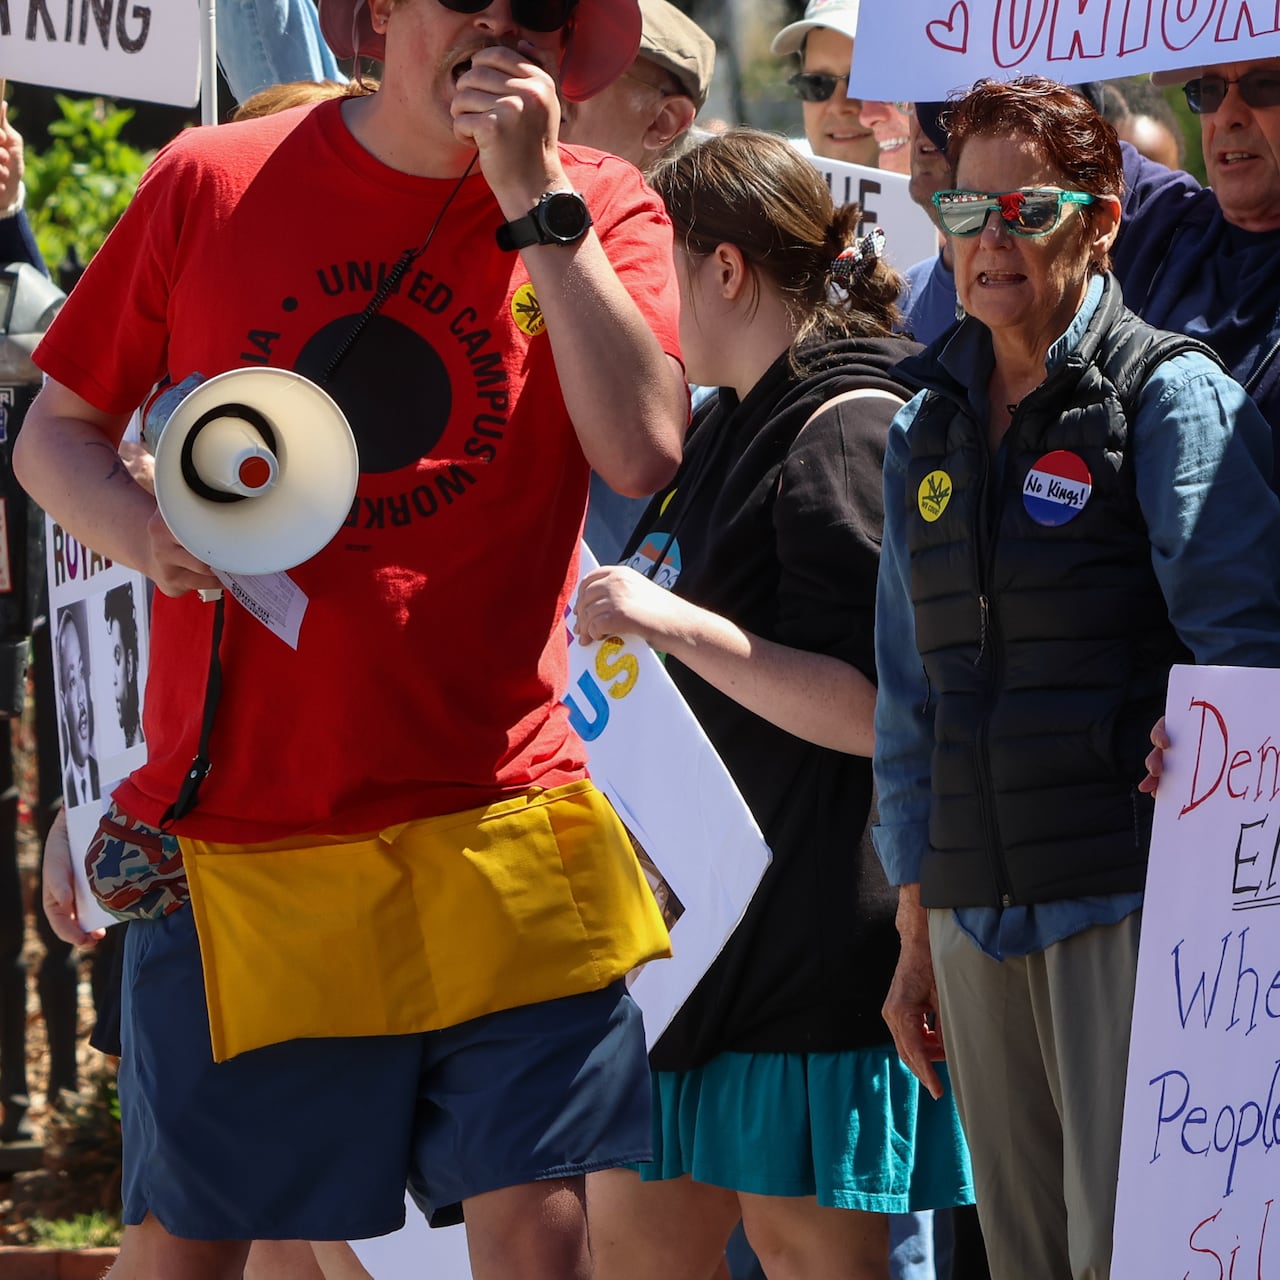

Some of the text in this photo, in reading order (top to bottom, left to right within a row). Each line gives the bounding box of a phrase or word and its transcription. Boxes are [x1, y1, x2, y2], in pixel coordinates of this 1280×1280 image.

[317, 260, 454, 315] UNITED
[449, 306, 510, 463] CAMPUS
[1025, 474, 1087, 508] No Kings!
